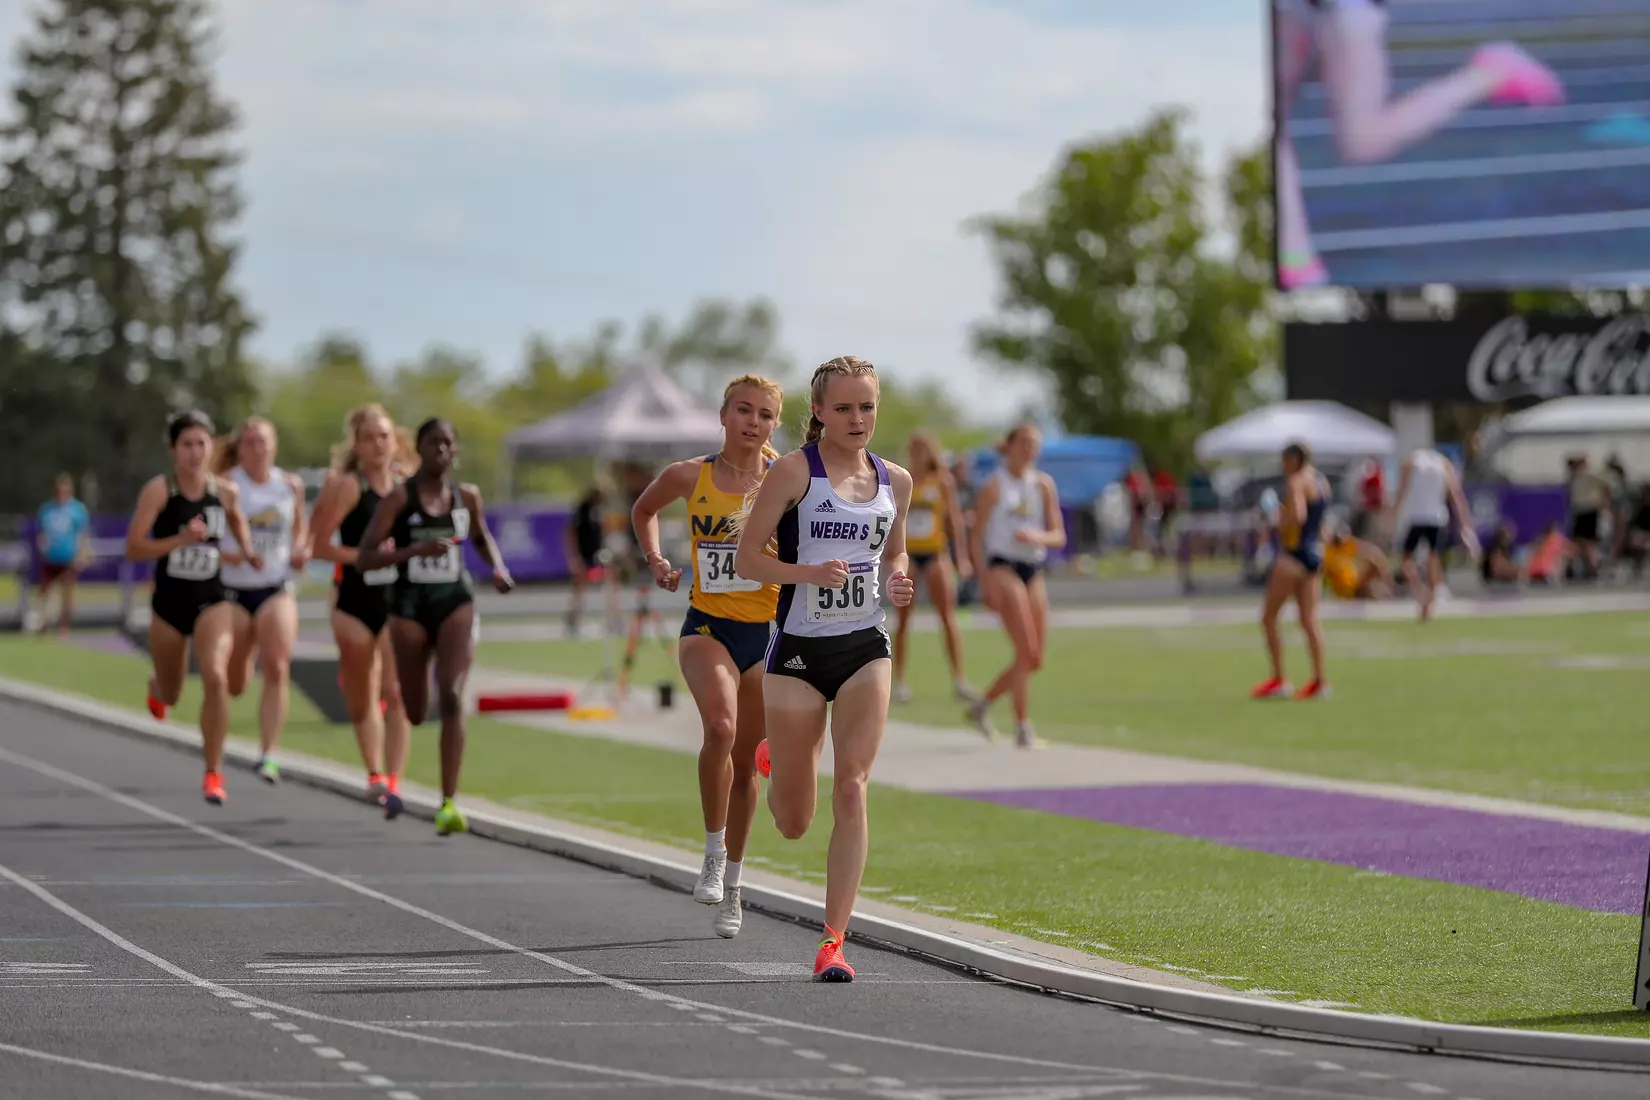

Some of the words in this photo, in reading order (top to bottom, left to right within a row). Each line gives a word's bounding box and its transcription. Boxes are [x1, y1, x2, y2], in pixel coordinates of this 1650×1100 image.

[810, 520, 858, 540] WEBER
[860, 523, 870, 540] S
[869, 515, 888, 551] 5
[818, 575, 865, 609] 536
[783, 661, 807, 670] adidas
